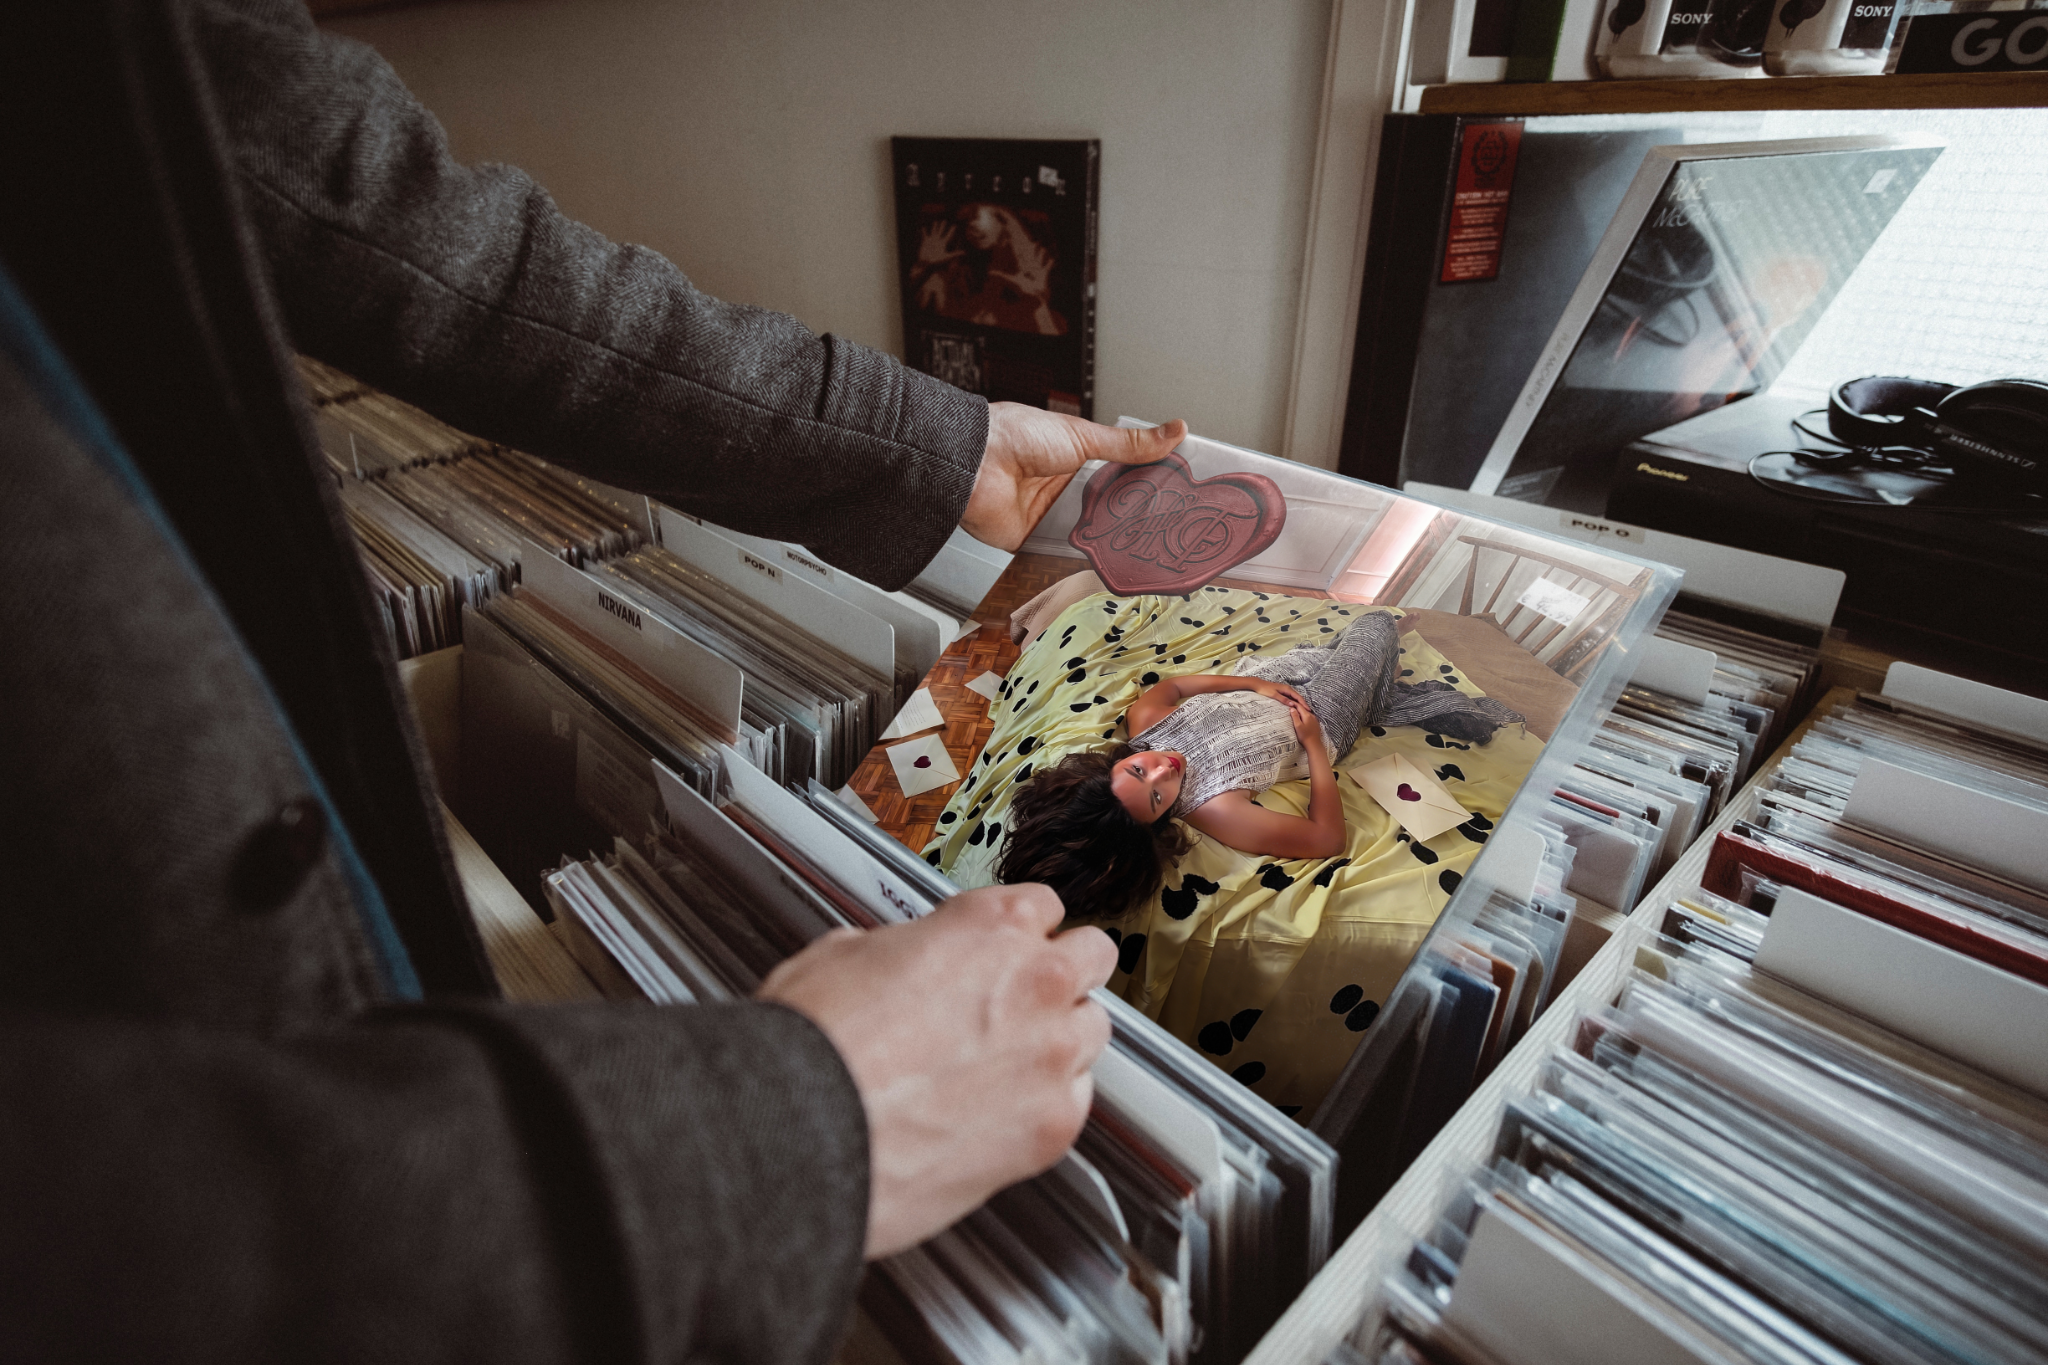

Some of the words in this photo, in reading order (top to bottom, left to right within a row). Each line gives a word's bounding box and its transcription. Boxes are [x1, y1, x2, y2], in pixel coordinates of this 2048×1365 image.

[1671, 13, 1713, 25] SONY
[1854, 5, 1893, 17] SONY
[1949, 434, 2021, 464] SENNHEISER
[1637, 462, 1689, 481] Pioneer
[1571, 519, 1610, 532] POP
[744, 555, 765, 571] POP
[767, 567, 776, 578] N
[598, 591, 642, 631] NIRVANA
